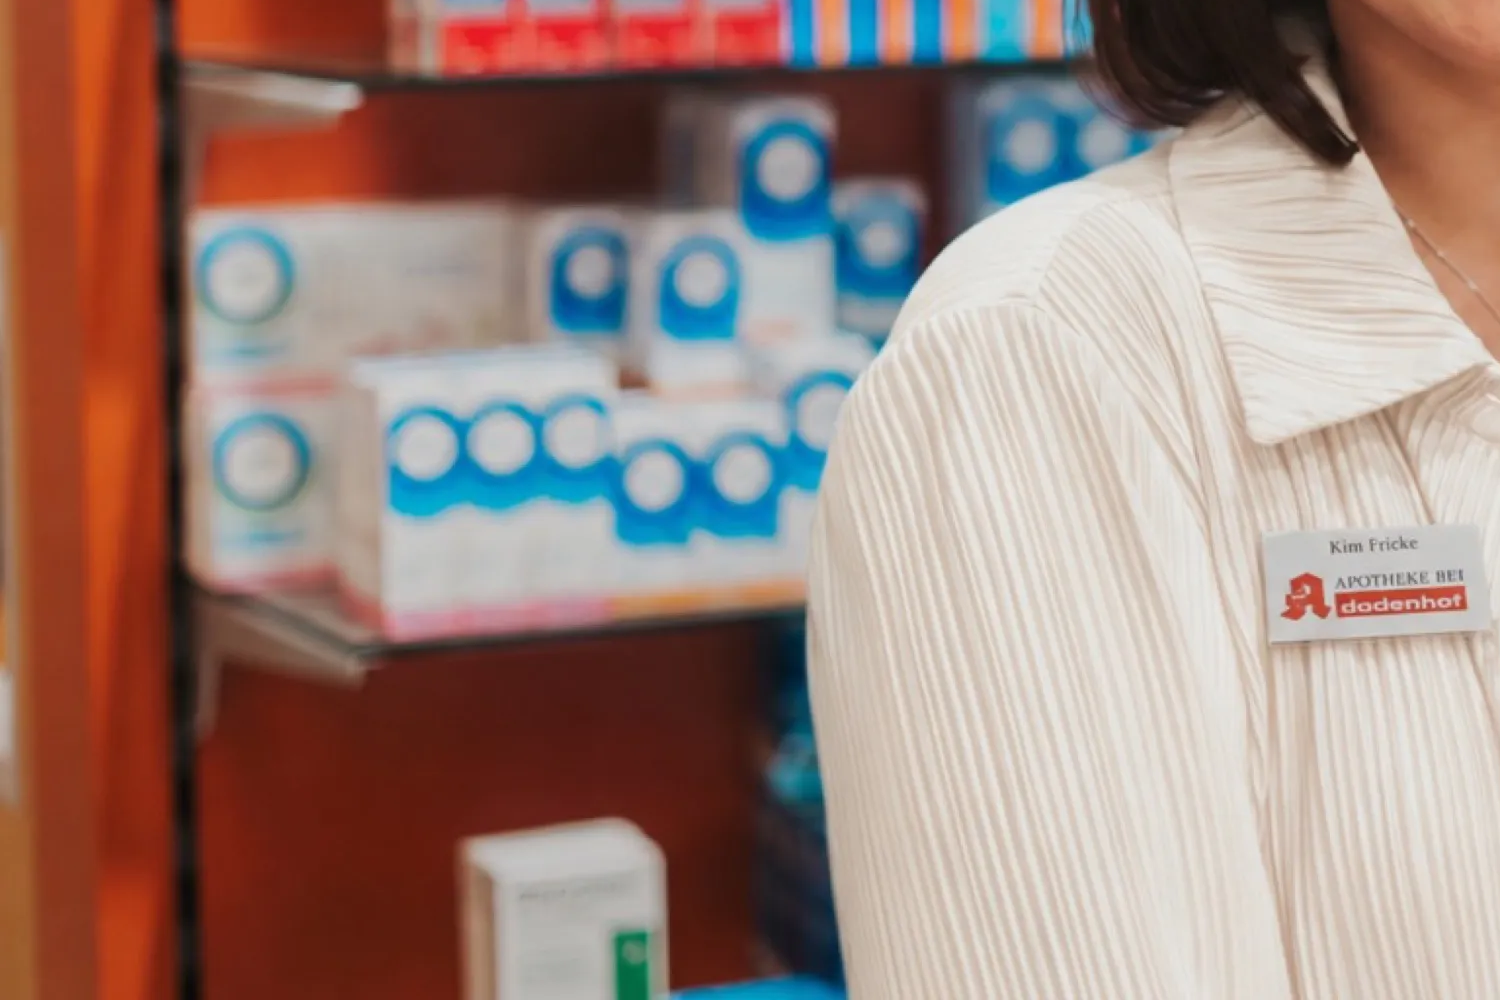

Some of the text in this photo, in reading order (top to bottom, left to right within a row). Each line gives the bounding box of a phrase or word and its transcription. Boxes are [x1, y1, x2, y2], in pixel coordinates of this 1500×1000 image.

[1329, 536, 1419, 555] Kim Fricke
[1335, 569, 1464, 589] APOTHEKE BEI
[1342, 593, 1462, 614] dodenhof
